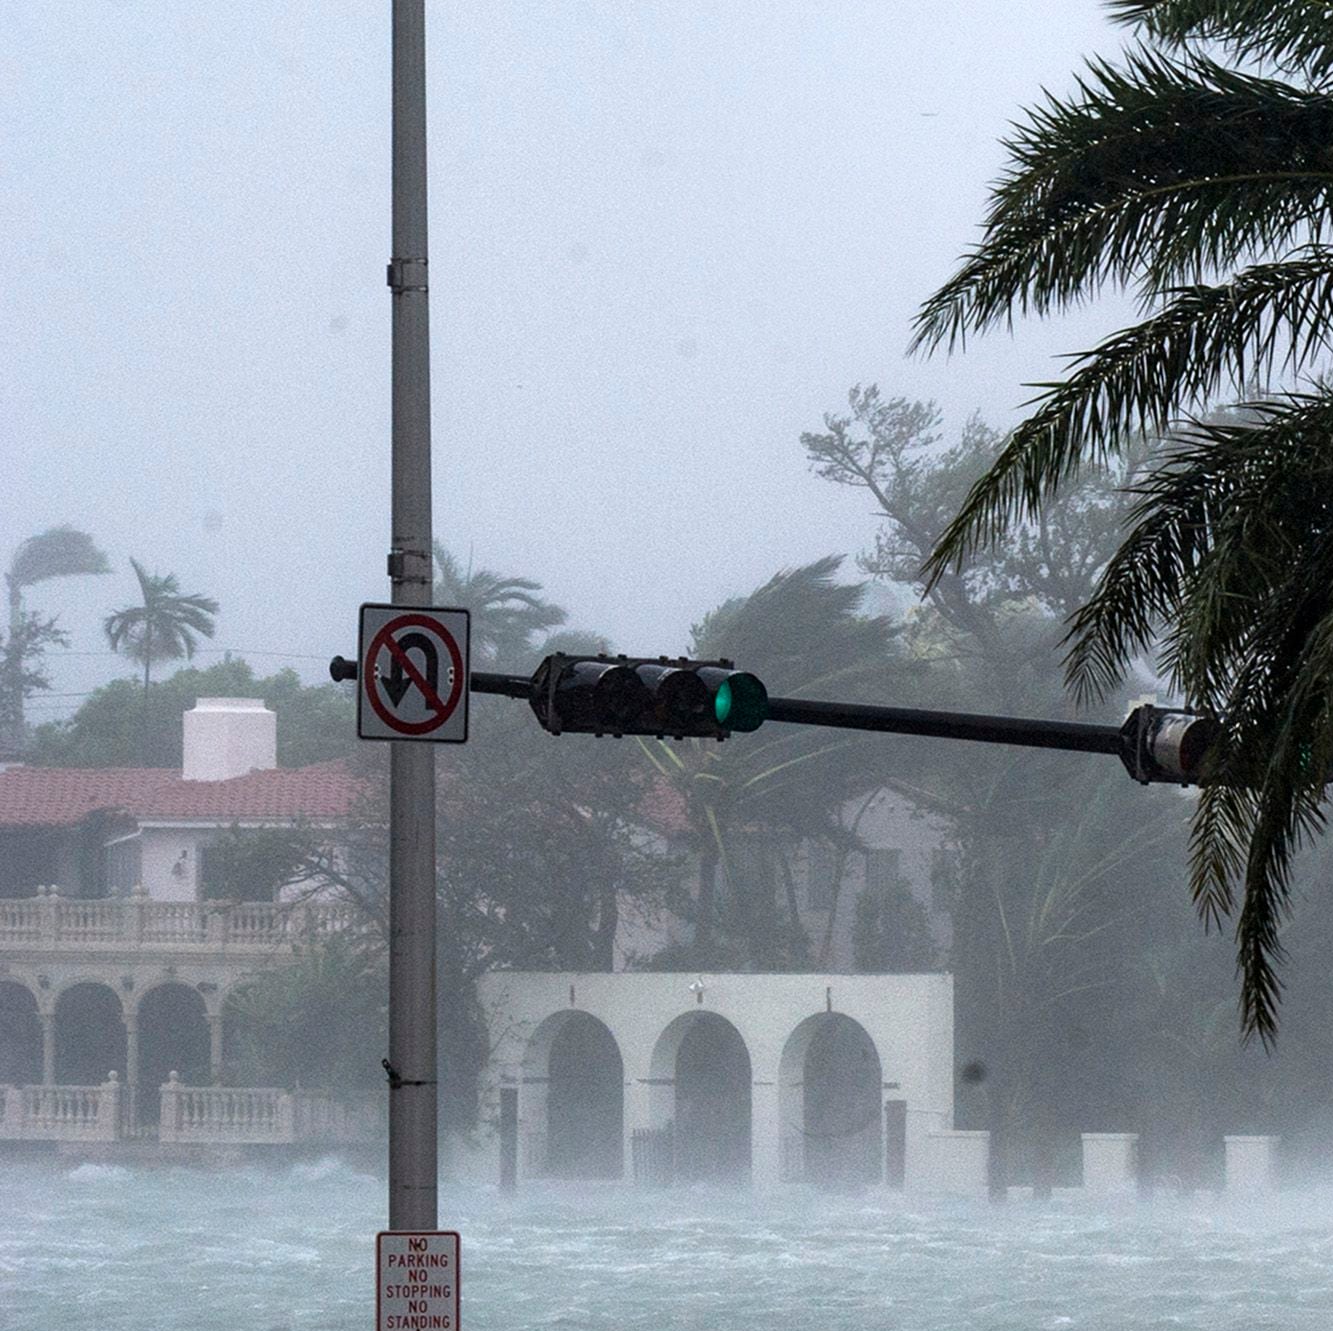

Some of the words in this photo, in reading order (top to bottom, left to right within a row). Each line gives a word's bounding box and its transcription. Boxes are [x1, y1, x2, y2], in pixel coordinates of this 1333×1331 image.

[408, 1238, 428, 1251] NO
[388, 1254, 448, 1268] PARKING
[408, 1269, 428, 1283] NO
[386, 1285, 451, 1299] STOPPING
[408, 1300, 428, 1314] NO
[386, 1315, 450, 1330] STANDING
